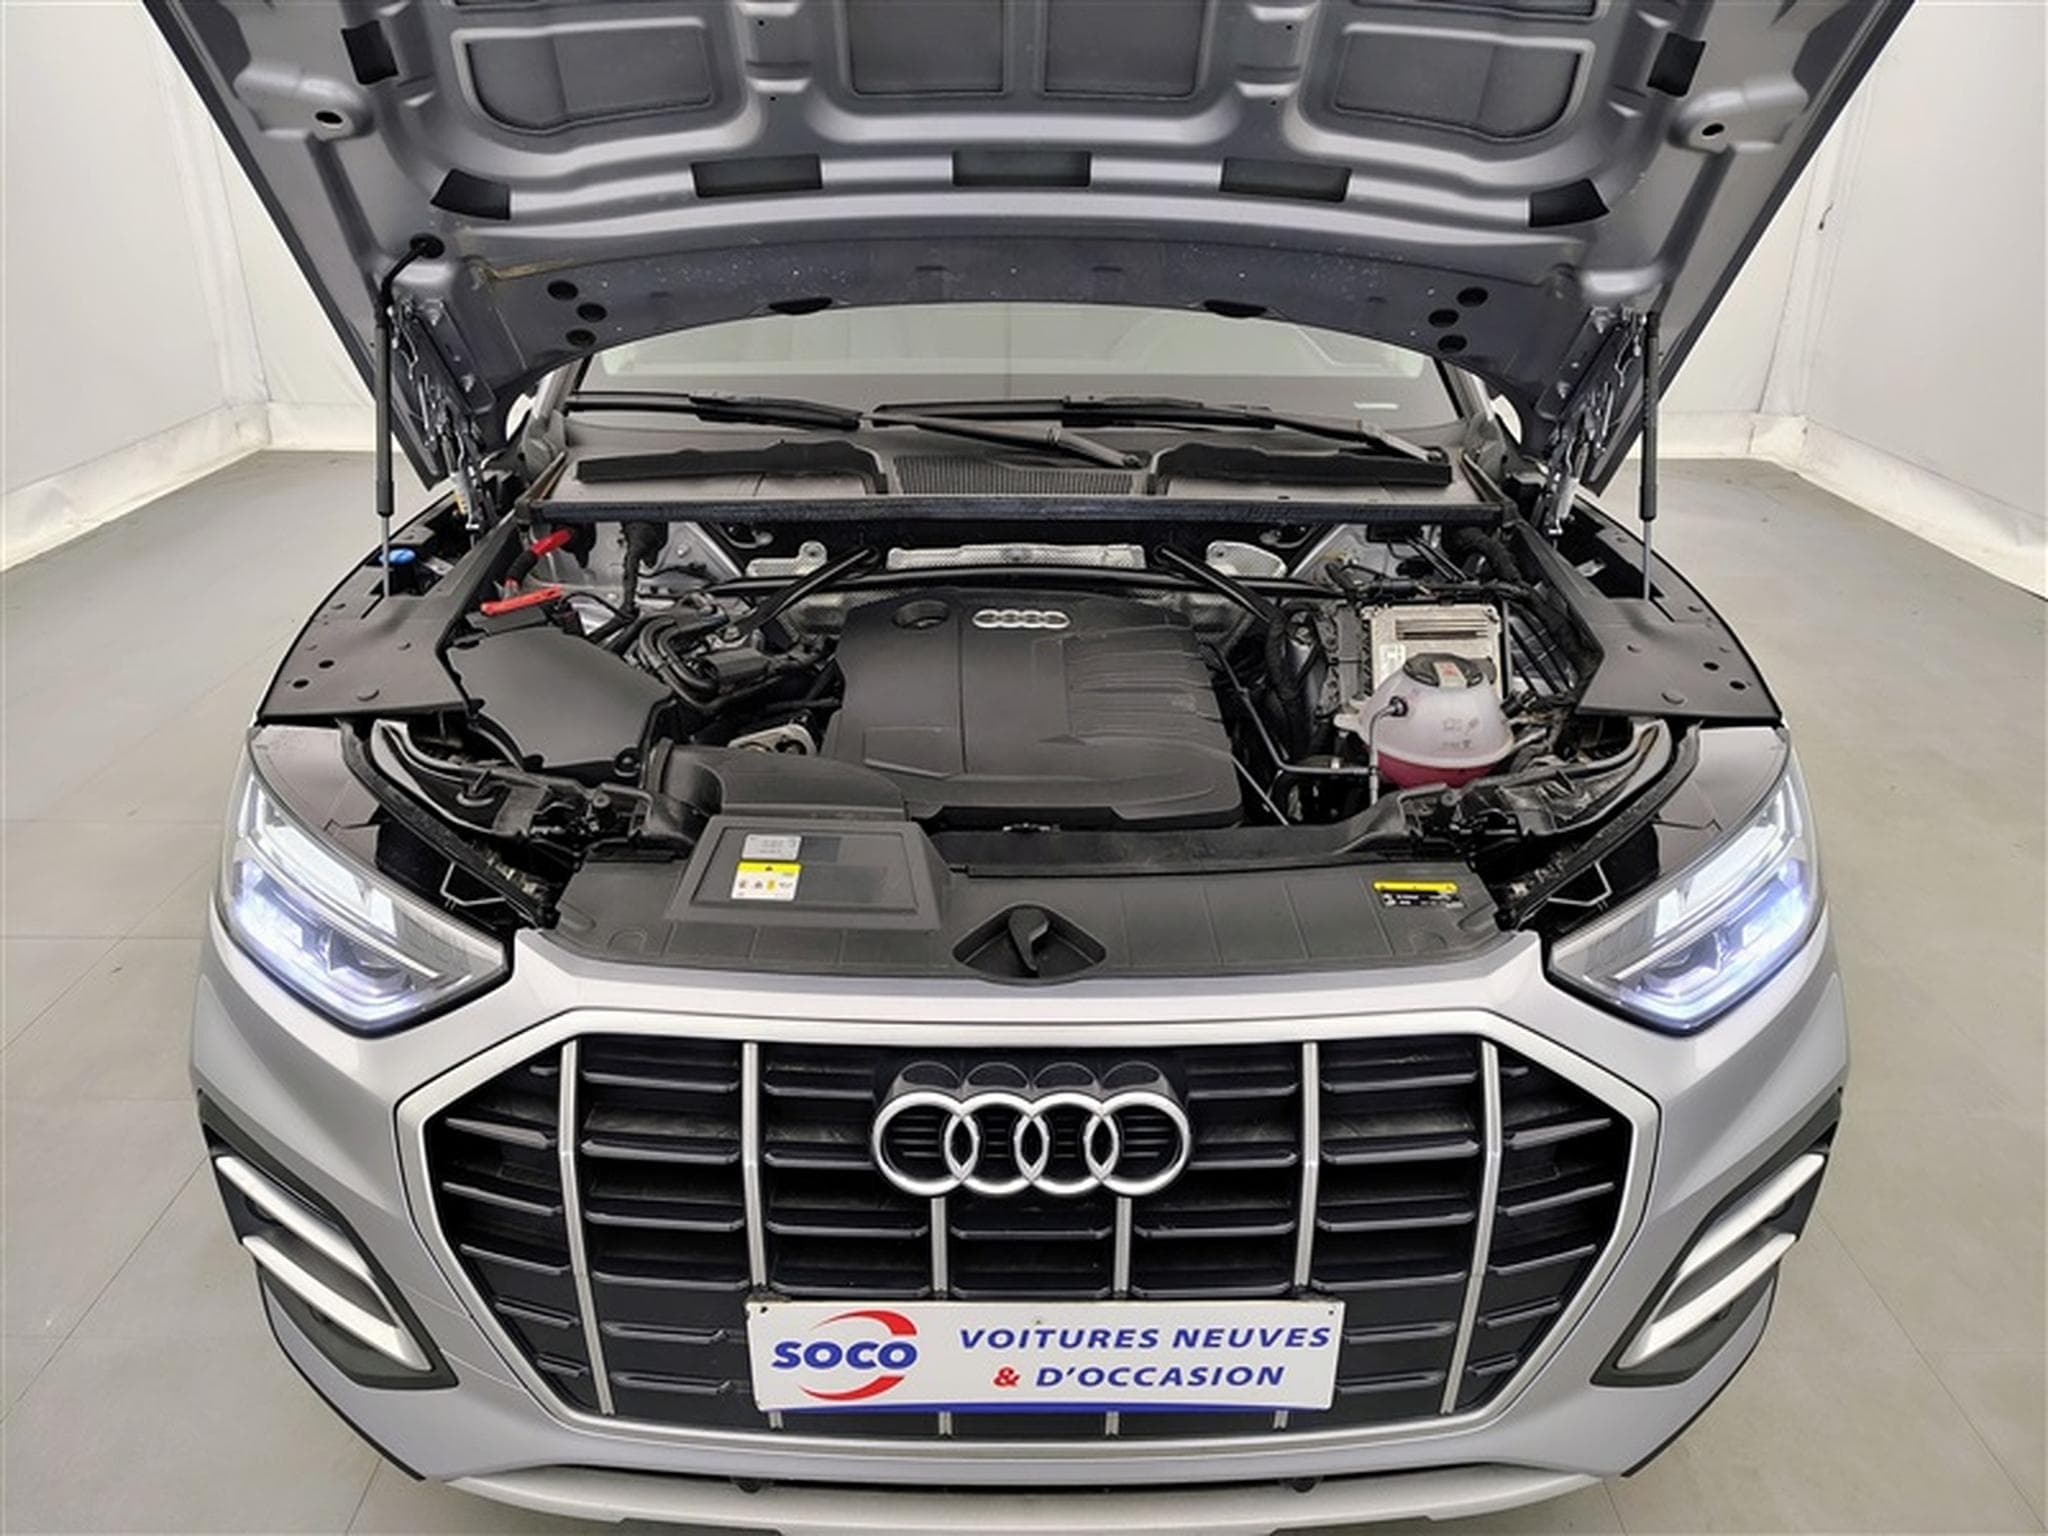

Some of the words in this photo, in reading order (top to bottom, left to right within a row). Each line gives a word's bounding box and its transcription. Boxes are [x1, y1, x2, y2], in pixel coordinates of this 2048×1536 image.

[960, 1327, 1159, 1349] VOITURES
[1172, 1326, 1331, 1349] NEUVES
[772, 1339, 918, 1370] SOCO
[993, 1366, 1020, 1389] &
[1035, 1365, 1285, 1388] D'OCCASION
